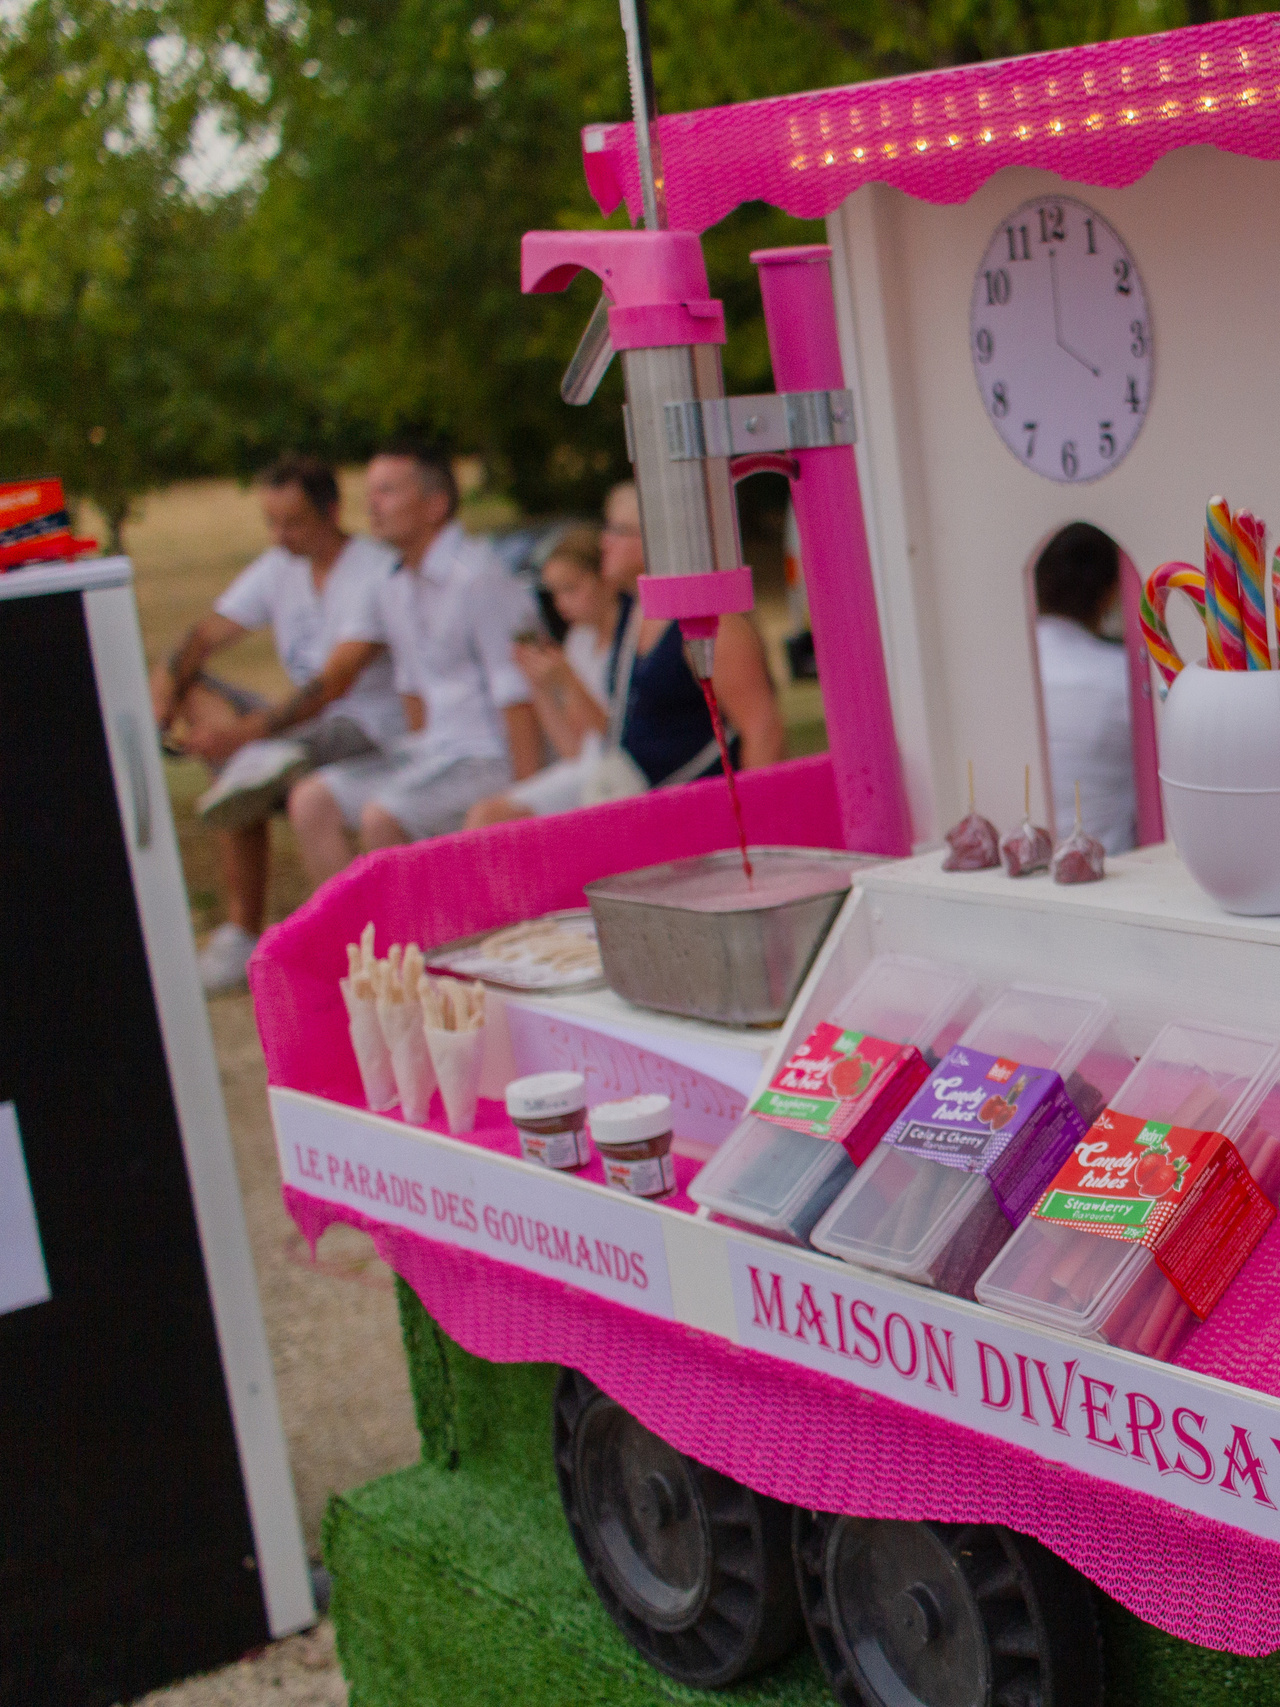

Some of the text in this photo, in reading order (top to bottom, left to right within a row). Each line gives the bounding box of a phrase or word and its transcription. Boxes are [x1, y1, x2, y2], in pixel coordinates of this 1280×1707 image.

[1038, 206, 1065, 243] 12
[1084, 218, 1097, 255] 1
[1006, 226, 1032, 261] 11
[984, 268, 1011, 306] 10
[1113, 259, 1131, 295] 2
[976, 328, 993, 364] 9
[1130, 320, 1147, 358] 3
[992, 381, 1009, 418] 8
[1125, 374, 1141, 413] 4
[1023, 421, 1038, 459] 7
[1100, 420, 1116, 459] 5
[1061, 440, 1079, 478] 6
[932, 1076, 988, 1110] Candy
[909, 1127, 935, 1141] Cola
[948, 1130, 985, 1148] Cherry
[1074, 1141, 1138, 1176] Candy
[1077, 1170, 1129, 1189] tubes
[294, 1143, 649, 1290] LE PARADIS DES GOURMANDS
[1064, 1197, 1134, 1215] Strawberry
[1072, 1210, 1116, 1221] flavoured
[745, 1264, 957, 1397] MAISON
